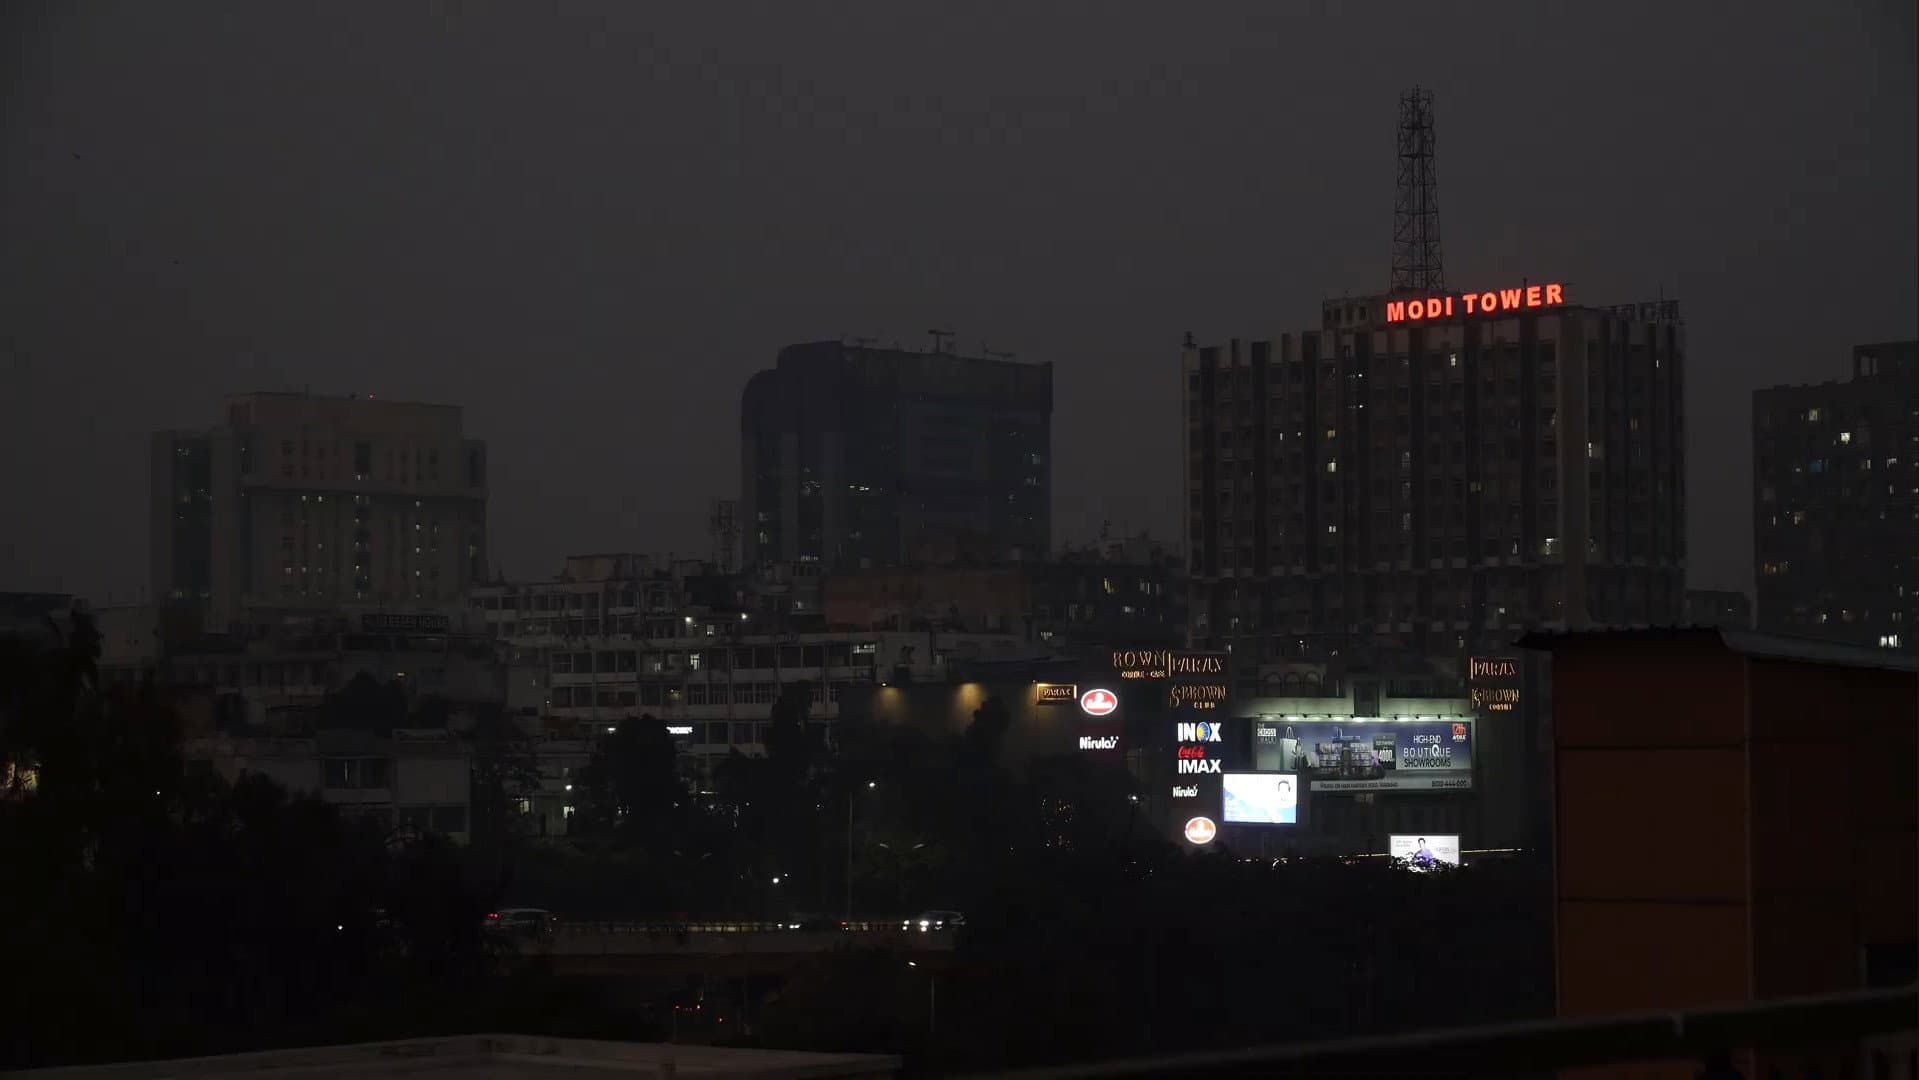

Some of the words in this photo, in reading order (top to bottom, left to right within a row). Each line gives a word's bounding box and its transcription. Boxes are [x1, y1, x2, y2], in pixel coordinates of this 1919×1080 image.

[1386, 297, 1453, 322] MODI
[1462, 284, 1563, 314] TOWER
[1177, 721, 1222, 743] INOX
[1079, 736, 1120, 750] Nirula's
[1403, 744, 1451, 758] BOUTIQUE
[1178, 759, 1222, 774] IMAX
[1404, 759, 1451, 768] SHOWROOMS
